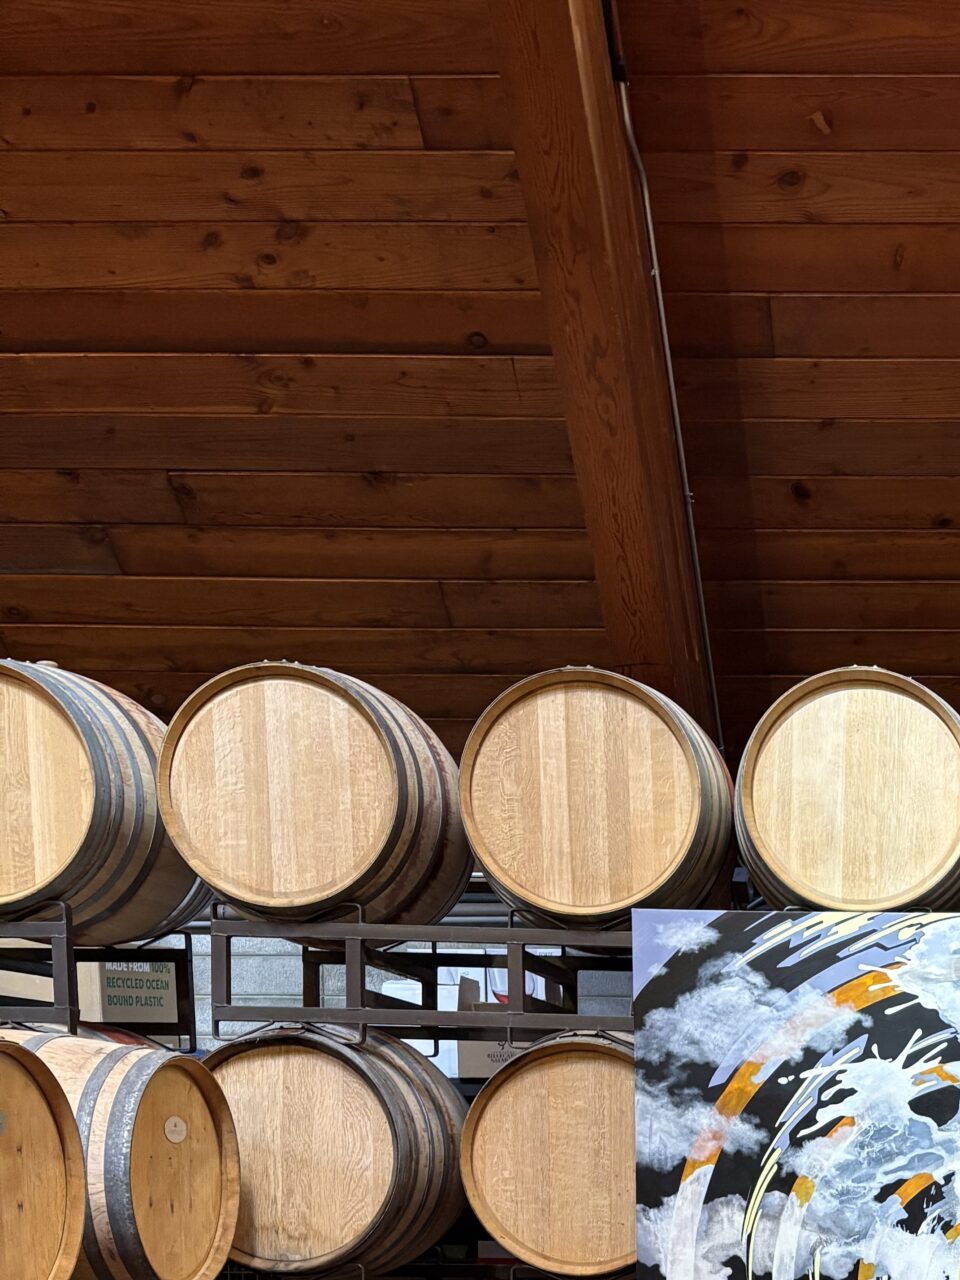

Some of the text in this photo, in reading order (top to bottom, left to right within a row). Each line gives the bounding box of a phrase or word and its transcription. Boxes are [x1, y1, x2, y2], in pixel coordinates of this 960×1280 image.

[105, 961, 128, 971] MADE
[128, 962, 150, 972] FROM
[106, 976, 170, 990] RECYCLED OCEAN
[107, 994, 164, 1007] BOUND PLASTIC
